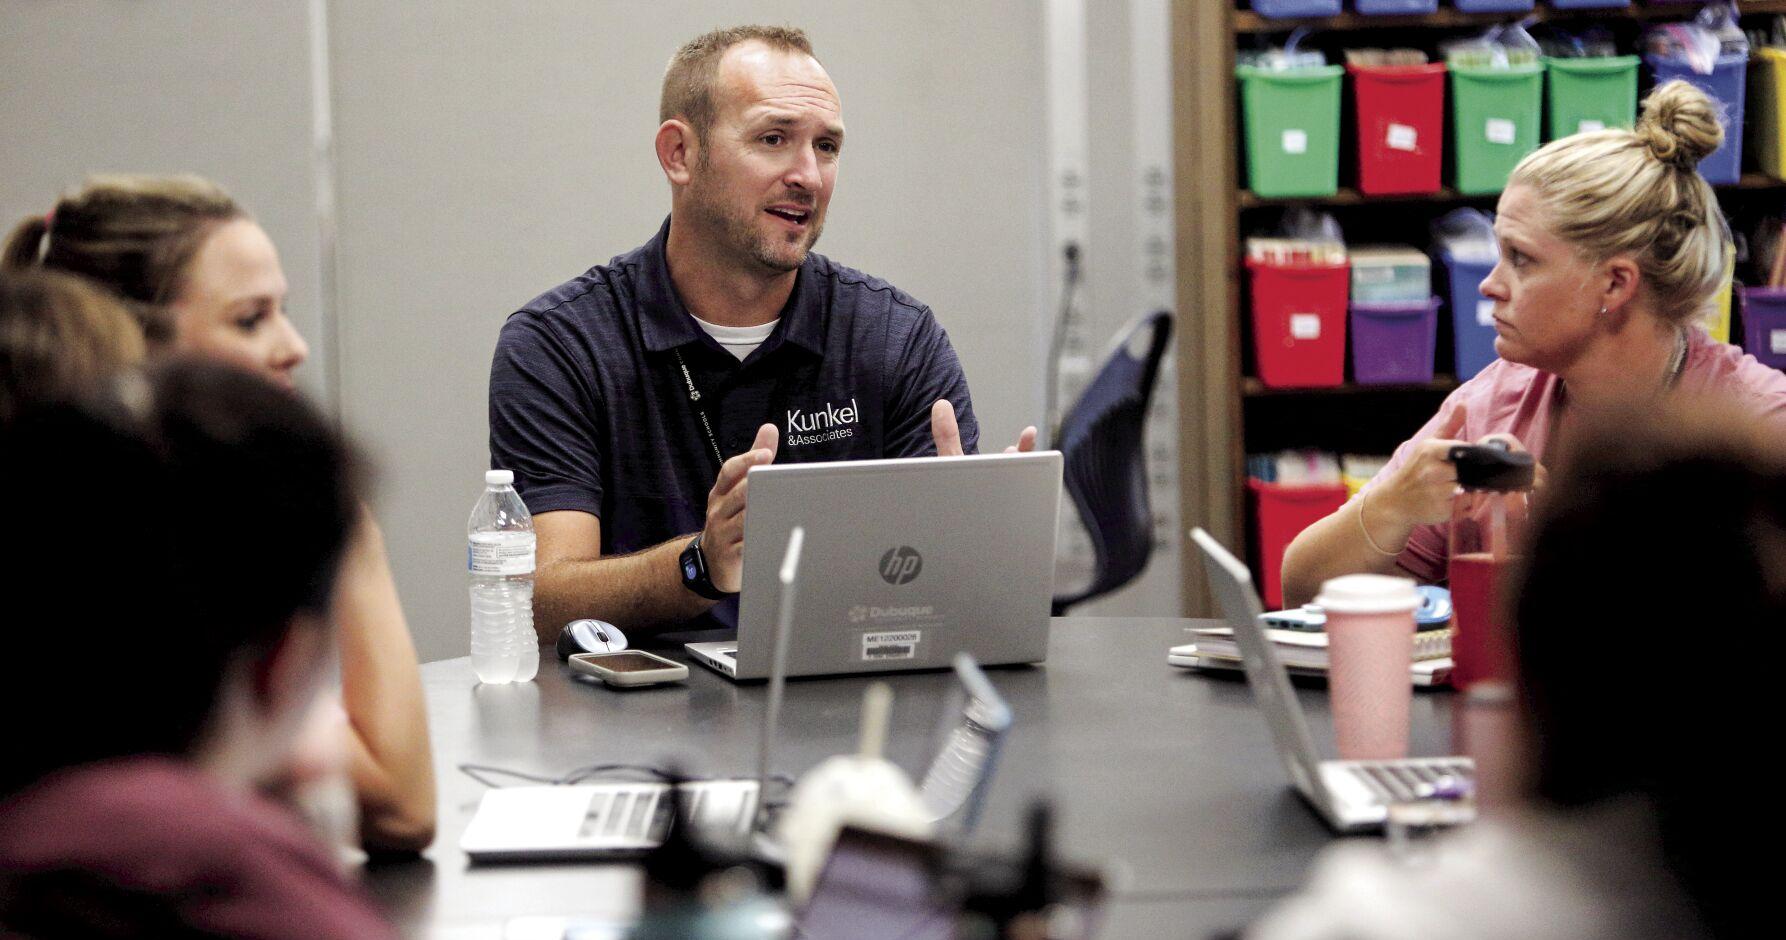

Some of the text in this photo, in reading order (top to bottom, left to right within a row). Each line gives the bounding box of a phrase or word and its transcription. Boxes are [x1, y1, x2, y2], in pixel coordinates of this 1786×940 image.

[681, 364, 696, 392] Dubuque
[786, 398, 859, 433] Kunkel
[788, 427, 854, 446] &Associates
[882, 547, 920, 585] hp
[869, 606, 934, 618] Dubuque
